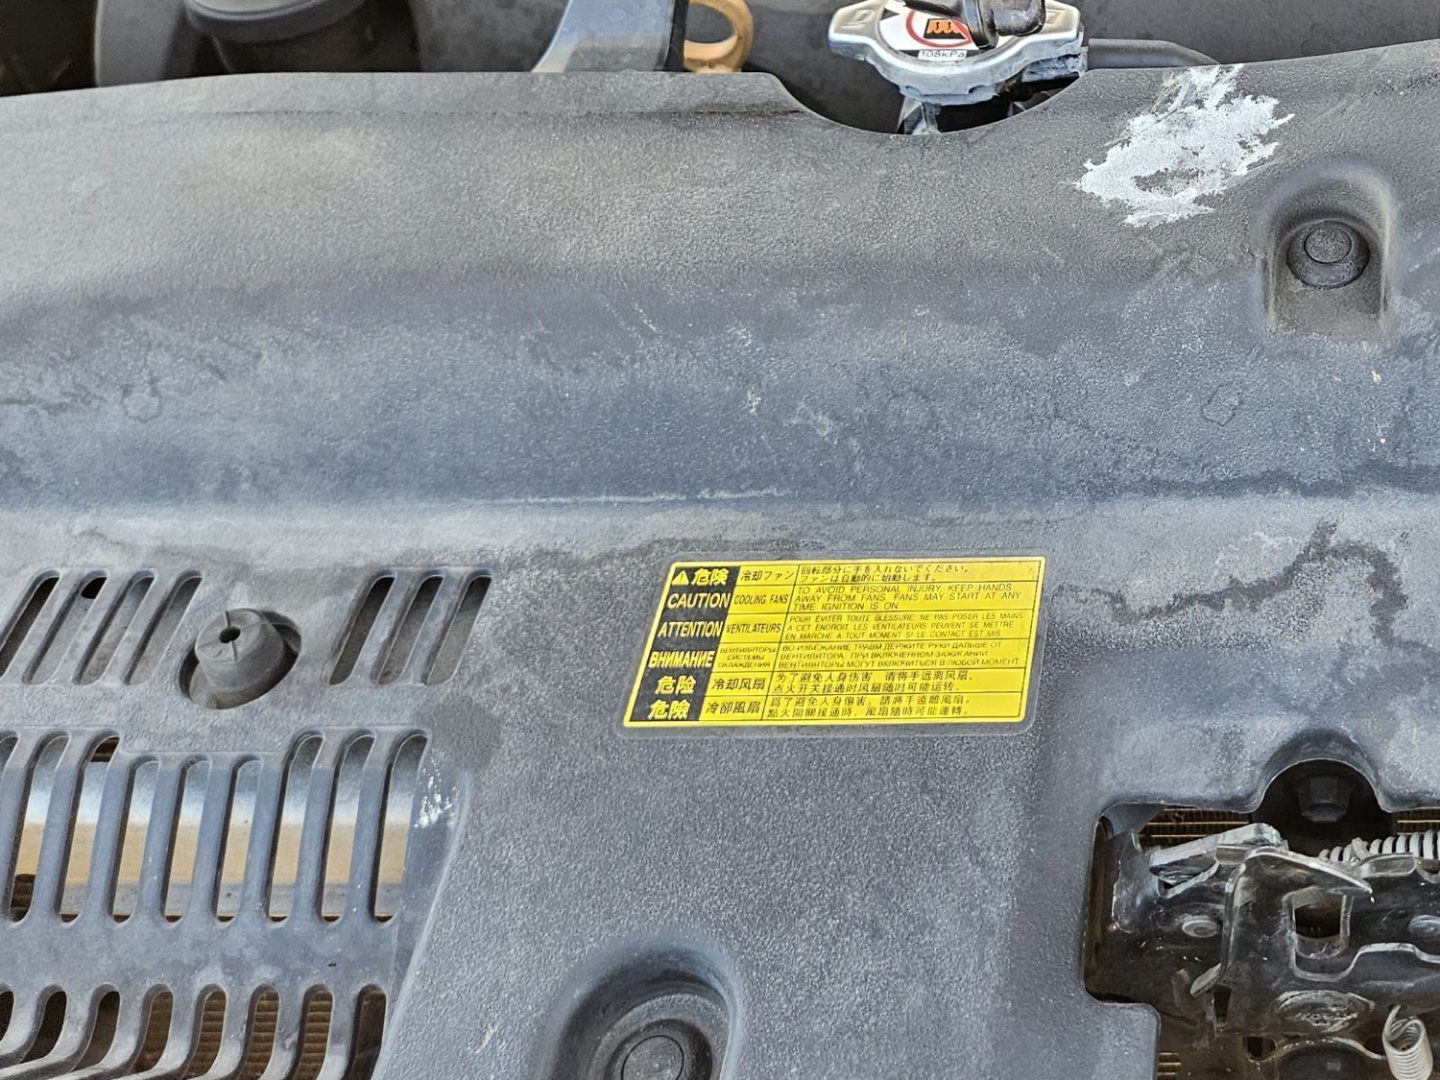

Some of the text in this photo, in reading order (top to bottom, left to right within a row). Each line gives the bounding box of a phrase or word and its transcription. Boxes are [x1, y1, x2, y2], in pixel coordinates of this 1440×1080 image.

[692, 568, 729, 585] 危険
[740, 570, 795, 581] 冷却ファン
[667, 592, 731, 609] CAUTION
[734, 594, 788, 605] COOLING FANS
[894, 592, 918, 601] FANS
[658, 621, 723, 637] ATTENTION
[727, 623, 781, 634] VENTILATEURS
[873, 622, 927, 630] VENTILATEURS
[648, 651, 715, 668] ВНИМАНИЕ
[655, 675, 696, 694] 危险
[712, 678, 766, 691] 冷却风扇
[648, 700, 691, 719] 危險
